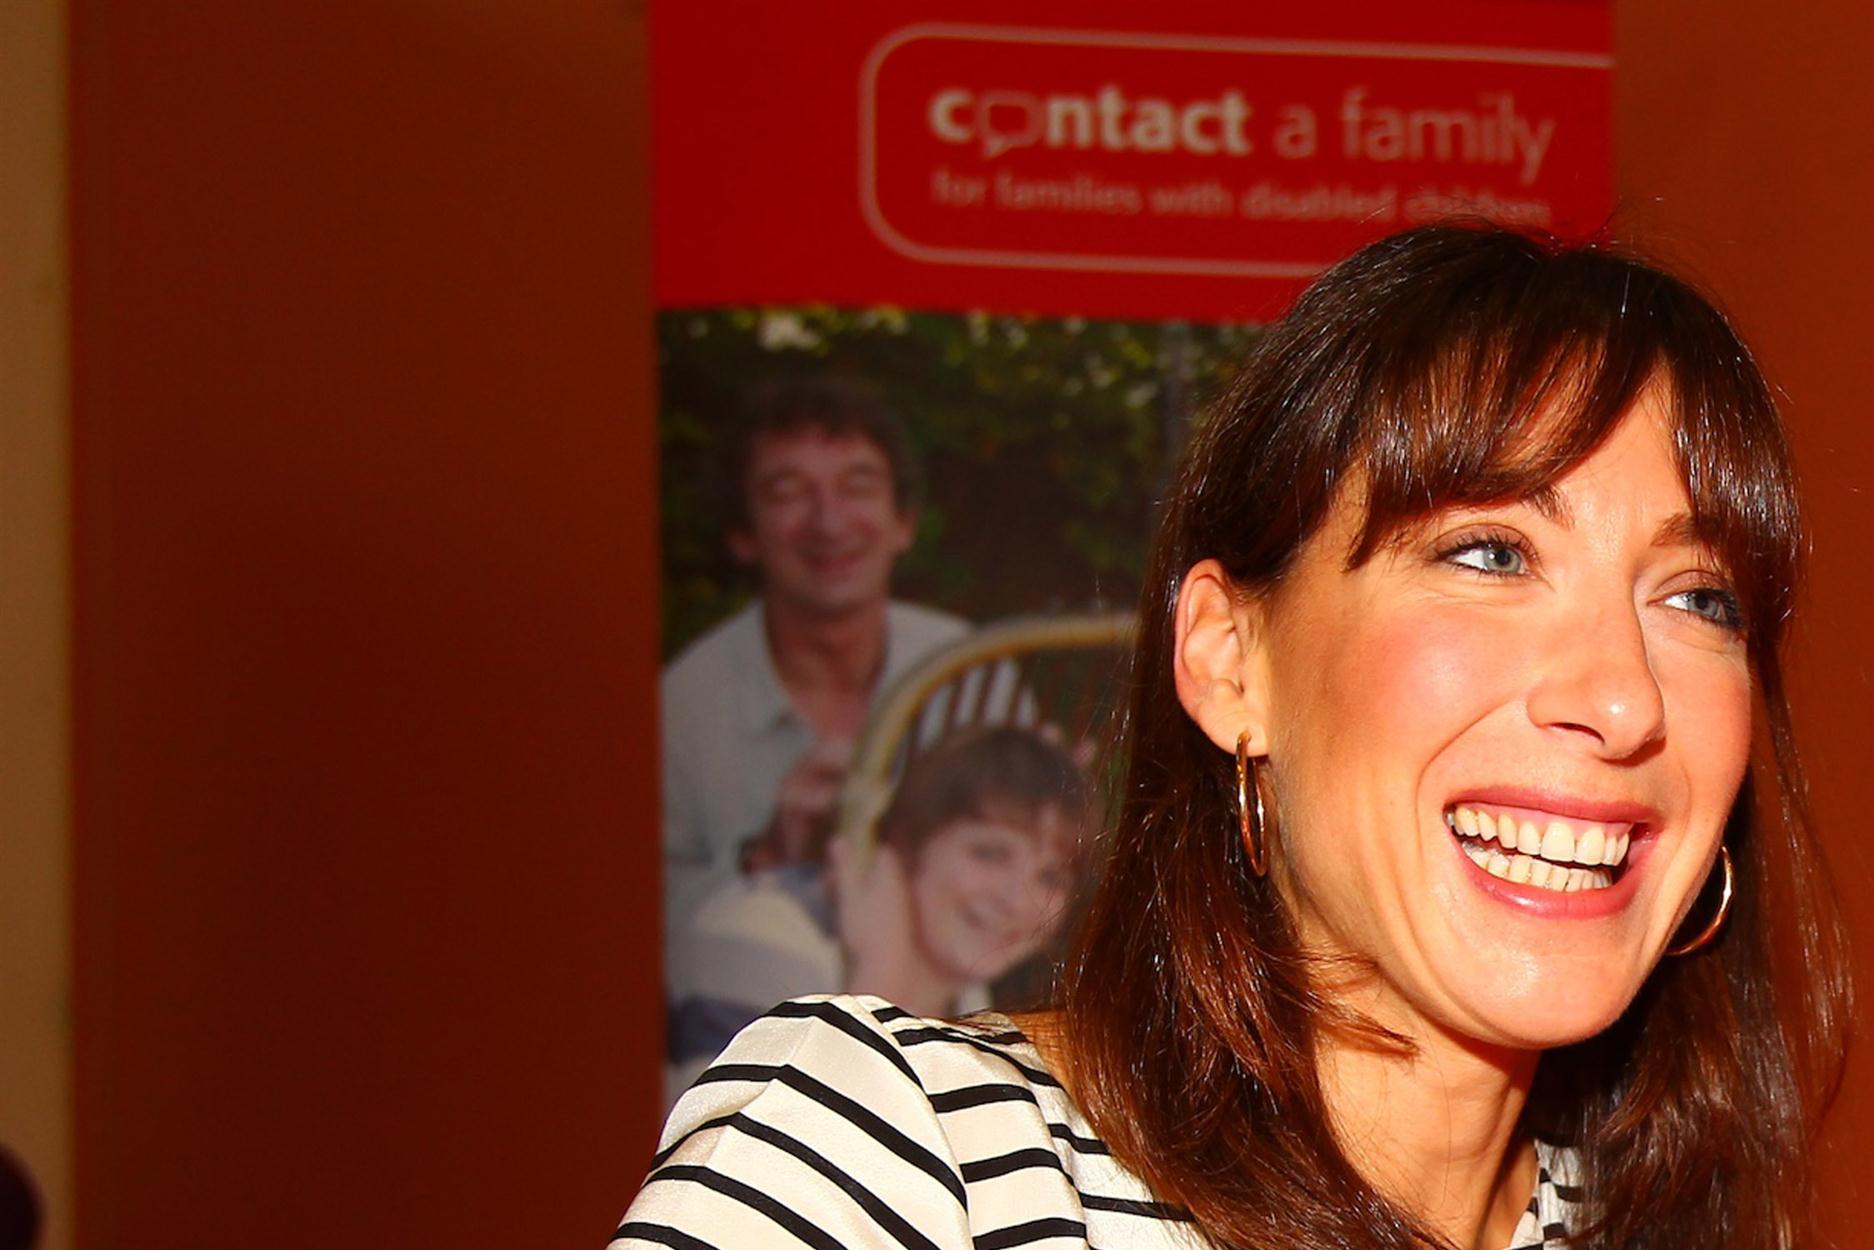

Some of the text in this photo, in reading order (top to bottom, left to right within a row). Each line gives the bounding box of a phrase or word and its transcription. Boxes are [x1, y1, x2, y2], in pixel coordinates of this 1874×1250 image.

[930, 86, 1556, 186] contact a family
